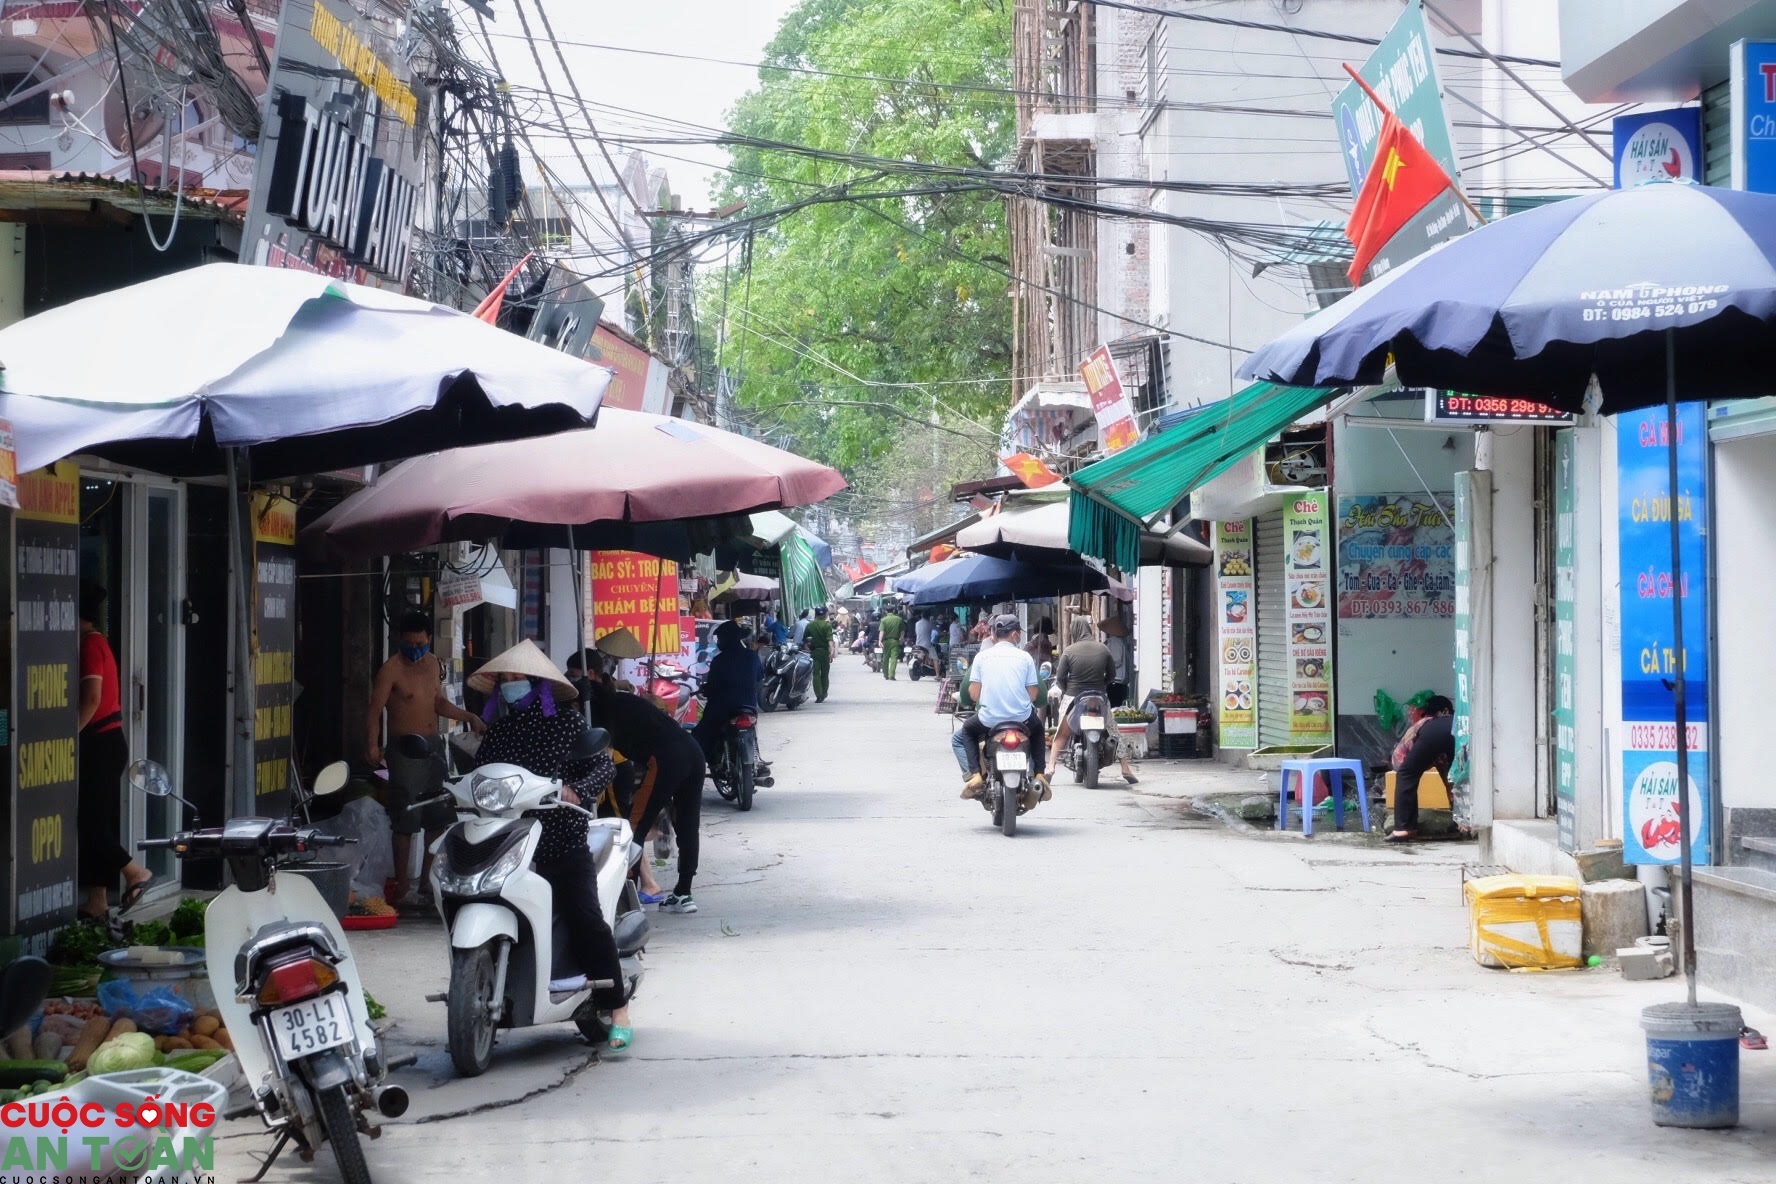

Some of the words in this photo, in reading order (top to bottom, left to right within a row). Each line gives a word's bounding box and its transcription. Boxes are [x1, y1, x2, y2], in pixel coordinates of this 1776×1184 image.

[1630, 134, 1648, 159] HẢI
[1649, 132, 1669, 157] SẢN
[1580, 289, 1633, 299] NAM
[1653, 285, 1729, 297] PHONG
[1611, 308, 1650, 321] 0984
[1654, 303, 1684, 317] 524
[1688, 299, 1718, 314] 079
[1449, 397, 1471, 411] ĐT:
[1475, 398, 1507, 412] 0356
[1511, 399, 1536, 413] 298
[1639, 414, 1657, 447] CÁ
[1293, 499, 1319, 513] Chè
[1631, 490, 1649, 522] CÁ
[1388, 545, 1413, 562] cung
[592, 559, 614, 579] BÁC
[638, 558, 676, 582] TRỌNG
[1638, 565, 1656, 598] CÁ
[611, 584, 658, 594] CHUYÊN:
[594, 598, 635, 615] KHÁM
[640, 598, 676, 616] BỆNH
[1373, 601, 1403, 614] 0393
[1406, 601, 1429, 614] 867
[1432, 601, 1455, 614] 886
[1640, 640, 1660, 674] CÁ
[27, 664, 68, 710] IPHONE
[1632, 725, 1656, 749] 0335
[19, 737, 75, 789] SAMSUNG
[1640, 771, 1656, 795] HẢI
[1658, 772, 1678, 796] SẢN
[32, 814, 62, 864] OPPO
[283, 999, 334, 1030] 30-L1
[291, 1021, 342, 1052] 4582
